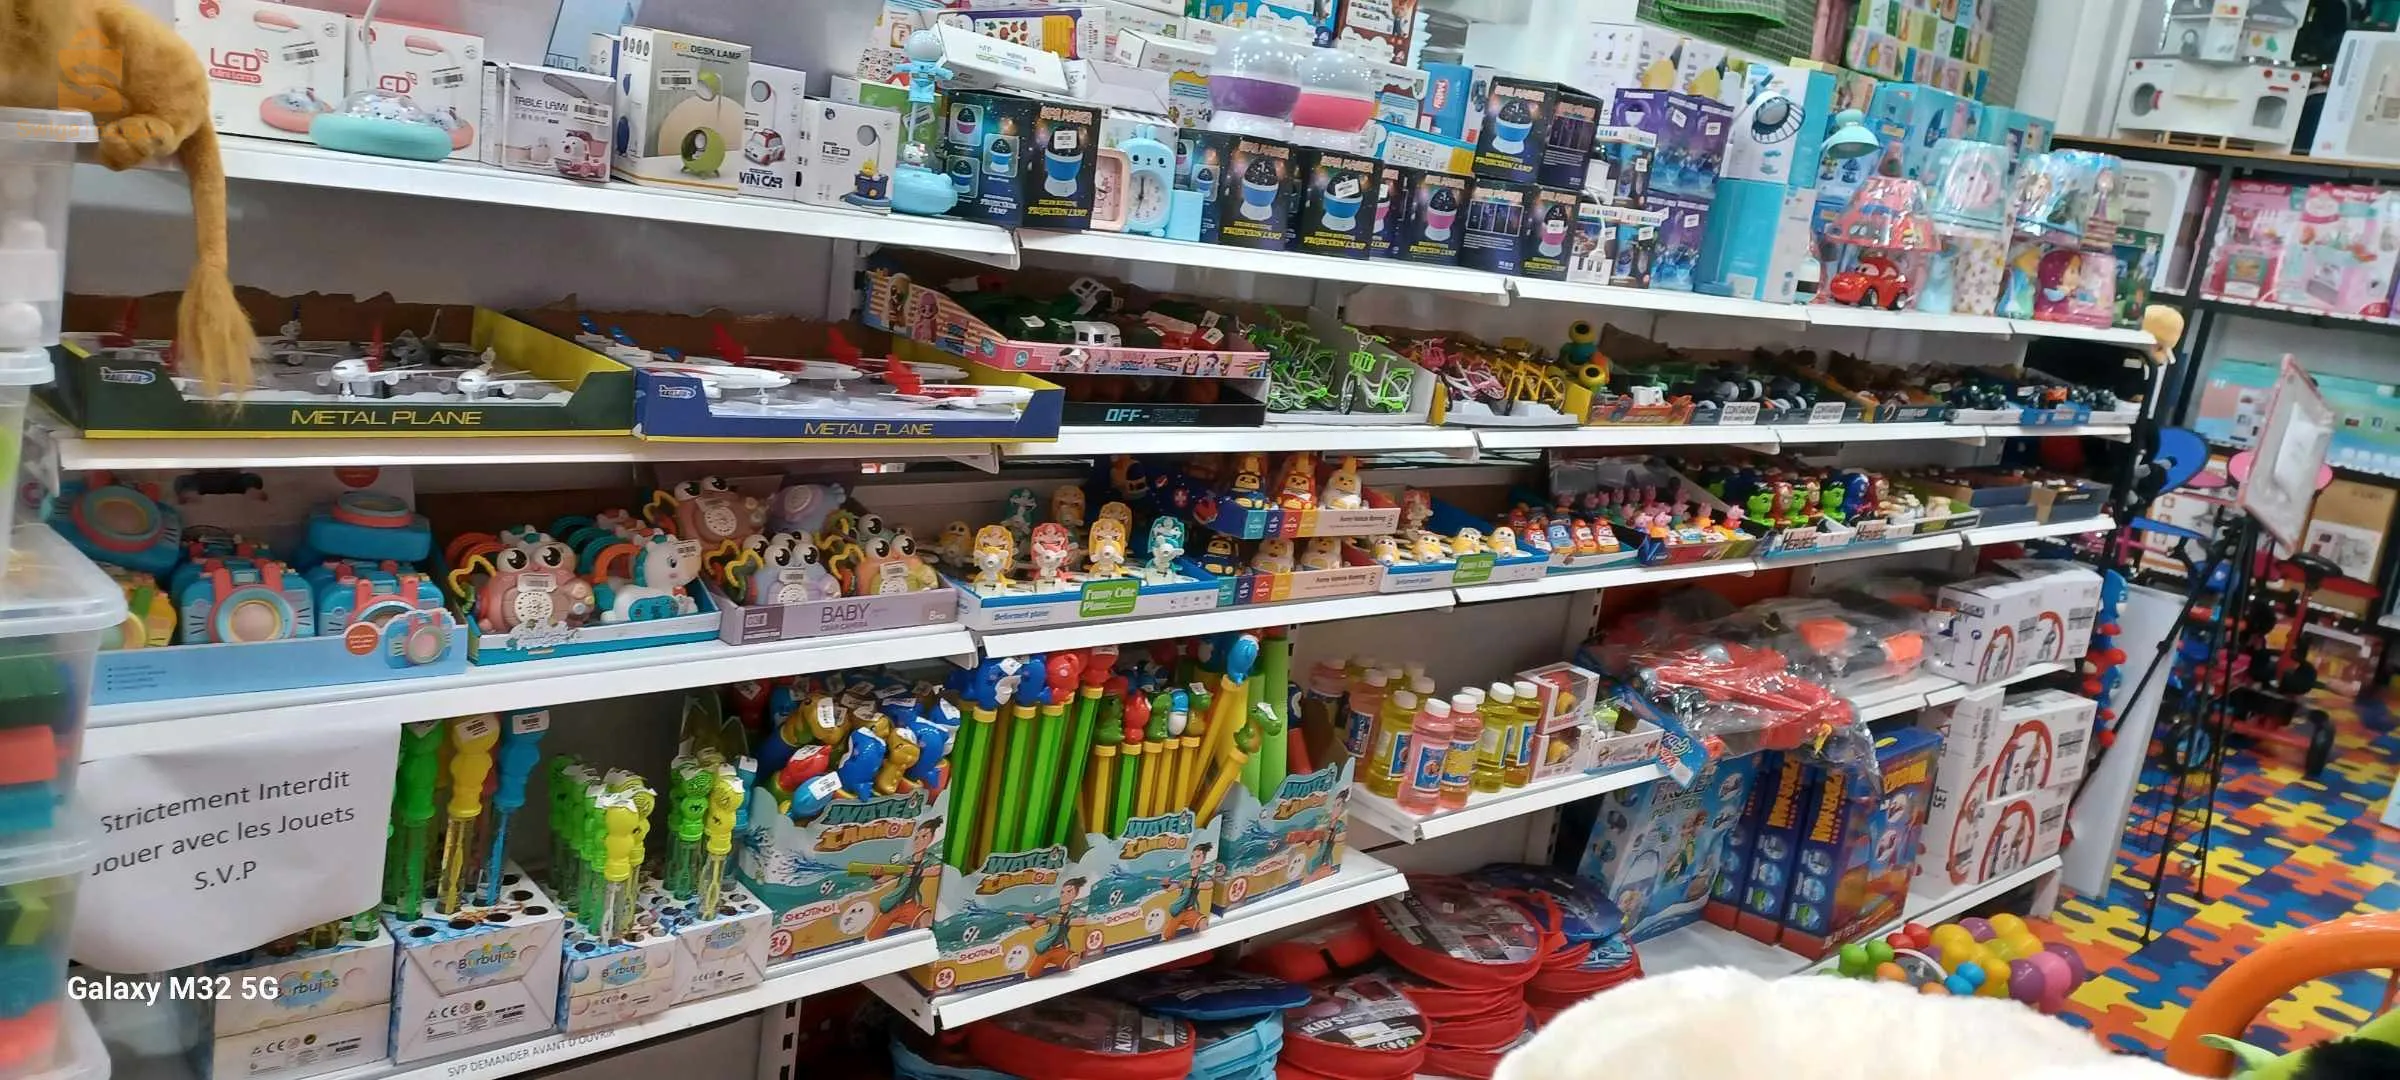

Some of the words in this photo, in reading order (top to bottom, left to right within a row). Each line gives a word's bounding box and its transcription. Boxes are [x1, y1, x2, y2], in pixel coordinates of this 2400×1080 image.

[211, 47, 260, 71] LED
[690, 45, 715, 58] DESK
[716, 49, 742, 61] LAMP
[513, 96, 543, 109] TABLE
[291, 409, 388, 426] METAL
[391, 409, 483, 425] PLANE
[804, 422, 871, 437] METAL
[873, 422, 934, 437] PLANE
[821, 603, 870, 623] BABY
[100, 787, 251, 833] Strictement
[259, 771, 350, 800] Interdit
[820, 791, 925, 824] WATER
[1933, 788, 1949, 810] SET
[172, 829, 230, 855] avec
[238, 821, 271, 841] les
[276, 806, 356, 834] Jouets
[980, 847, 1067, 874] WATER
[194, 860, 257, 890] S.V.P
[1302, 1014, 1345, 1035] KID'S
[448, 1062, 469, 1077] SVP
[470, 1049, 530, 1073] DEMANDER
[531, 1040, 565, 1057] AVANT
